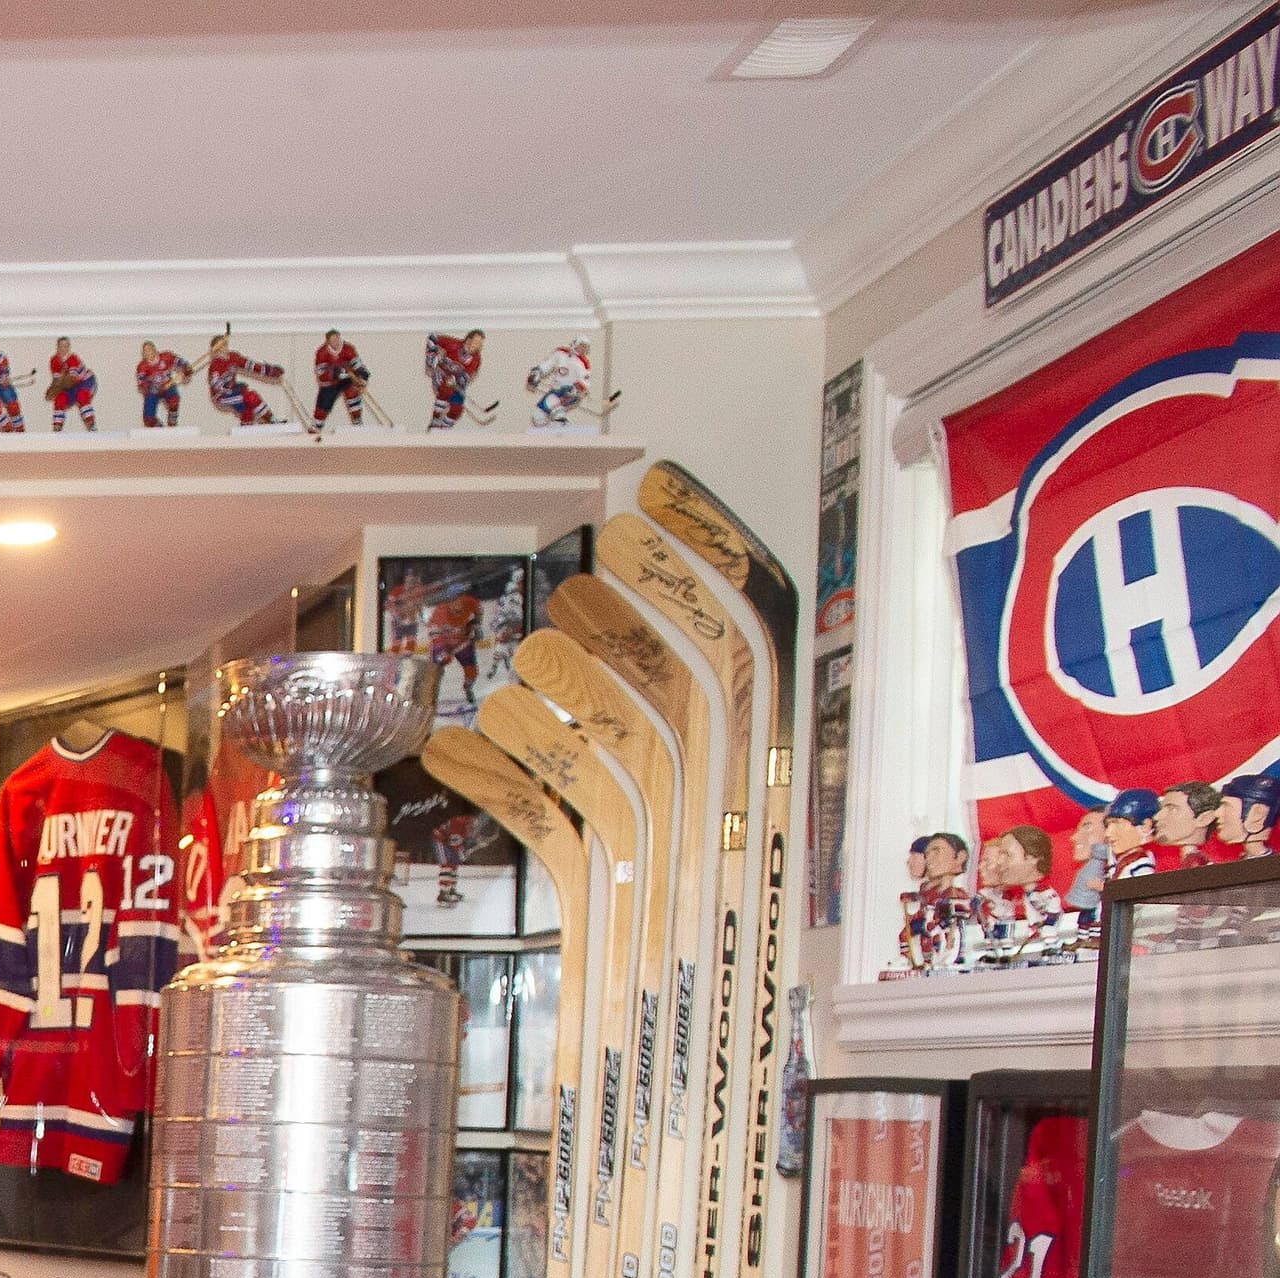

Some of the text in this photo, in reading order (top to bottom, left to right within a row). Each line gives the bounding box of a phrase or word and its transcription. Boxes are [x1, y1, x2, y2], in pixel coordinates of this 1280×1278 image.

[988, 25, 1280, 288] CANADIENS WAY
[120, 854, 175, 911] 12
